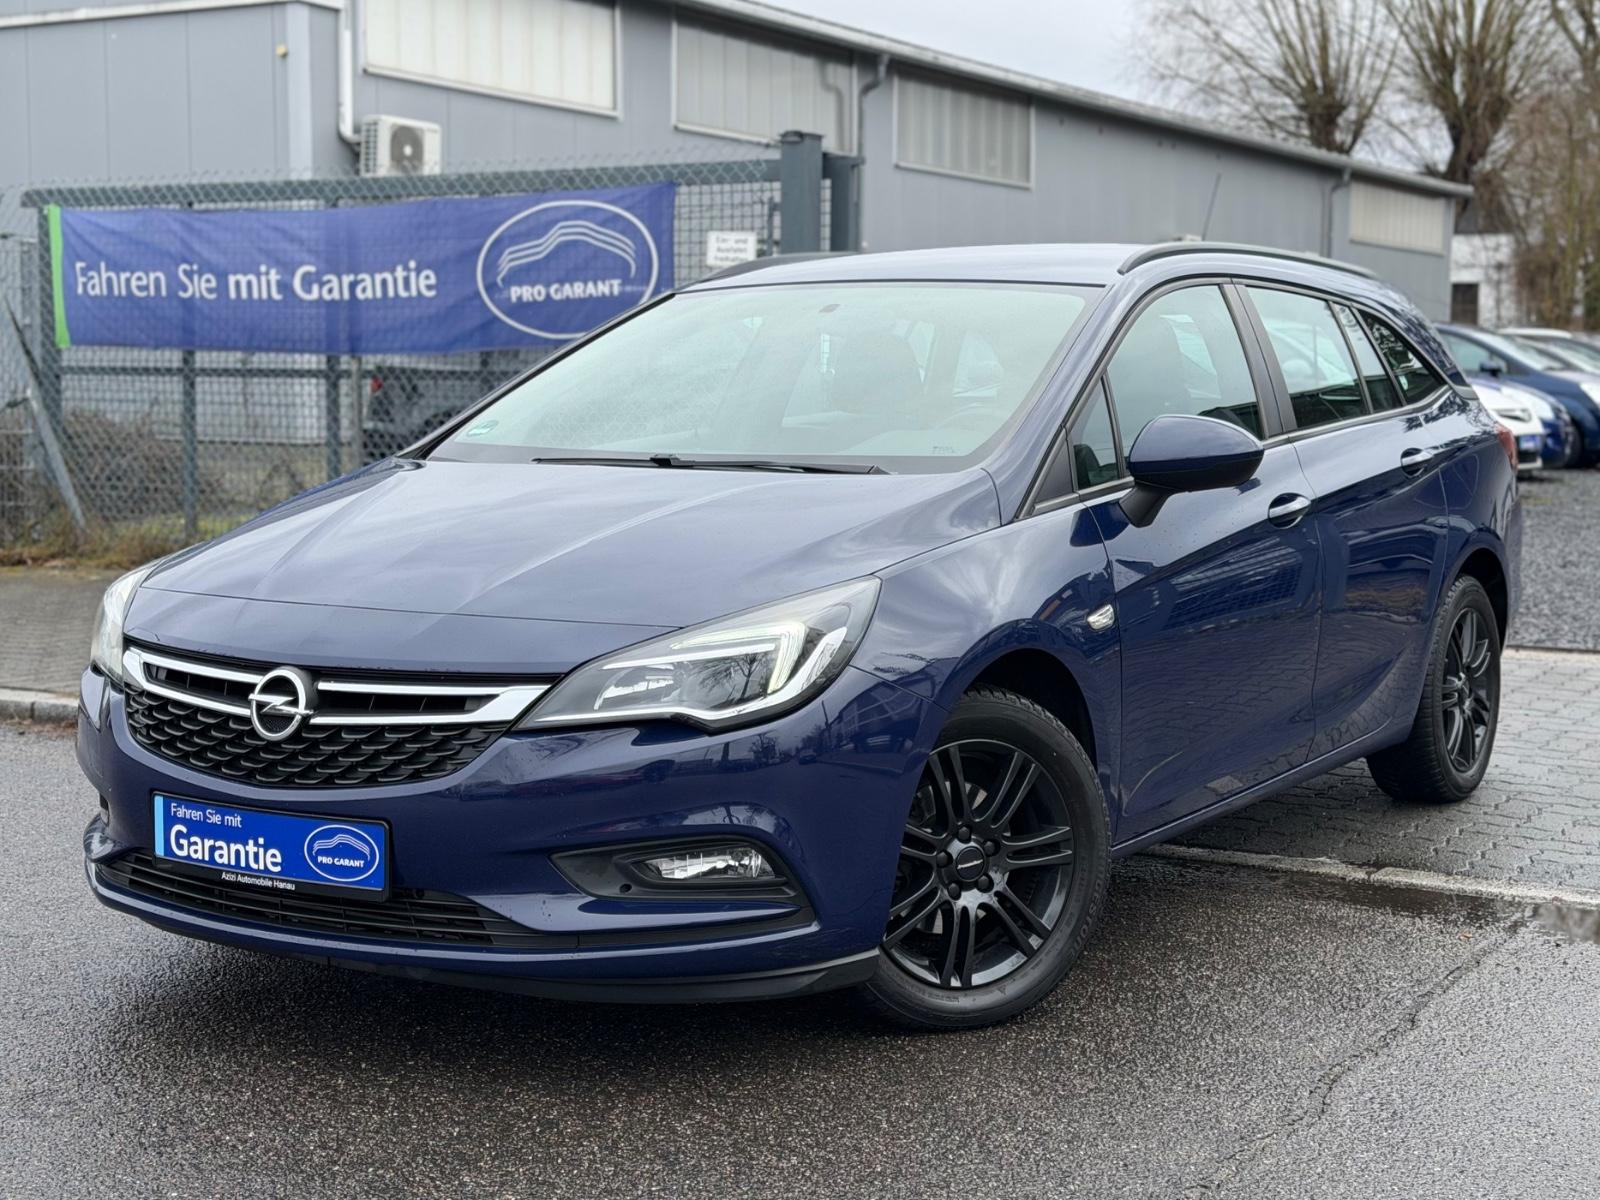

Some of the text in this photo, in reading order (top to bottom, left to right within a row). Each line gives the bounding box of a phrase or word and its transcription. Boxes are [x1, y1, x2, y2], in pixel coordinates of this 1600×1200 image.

[75, 259, 437, 301] Fahren Sie mit Garantie
[509, 278, 622, 304] PRO GARANT
[170, 802, 242, 829] Fahren Sie mit
[169, 823, 283, 874] Garantie
[317, 855, 365, 869] PRO GARANT
[221, 871, 296, 892] Azizi Automobile Hanau
